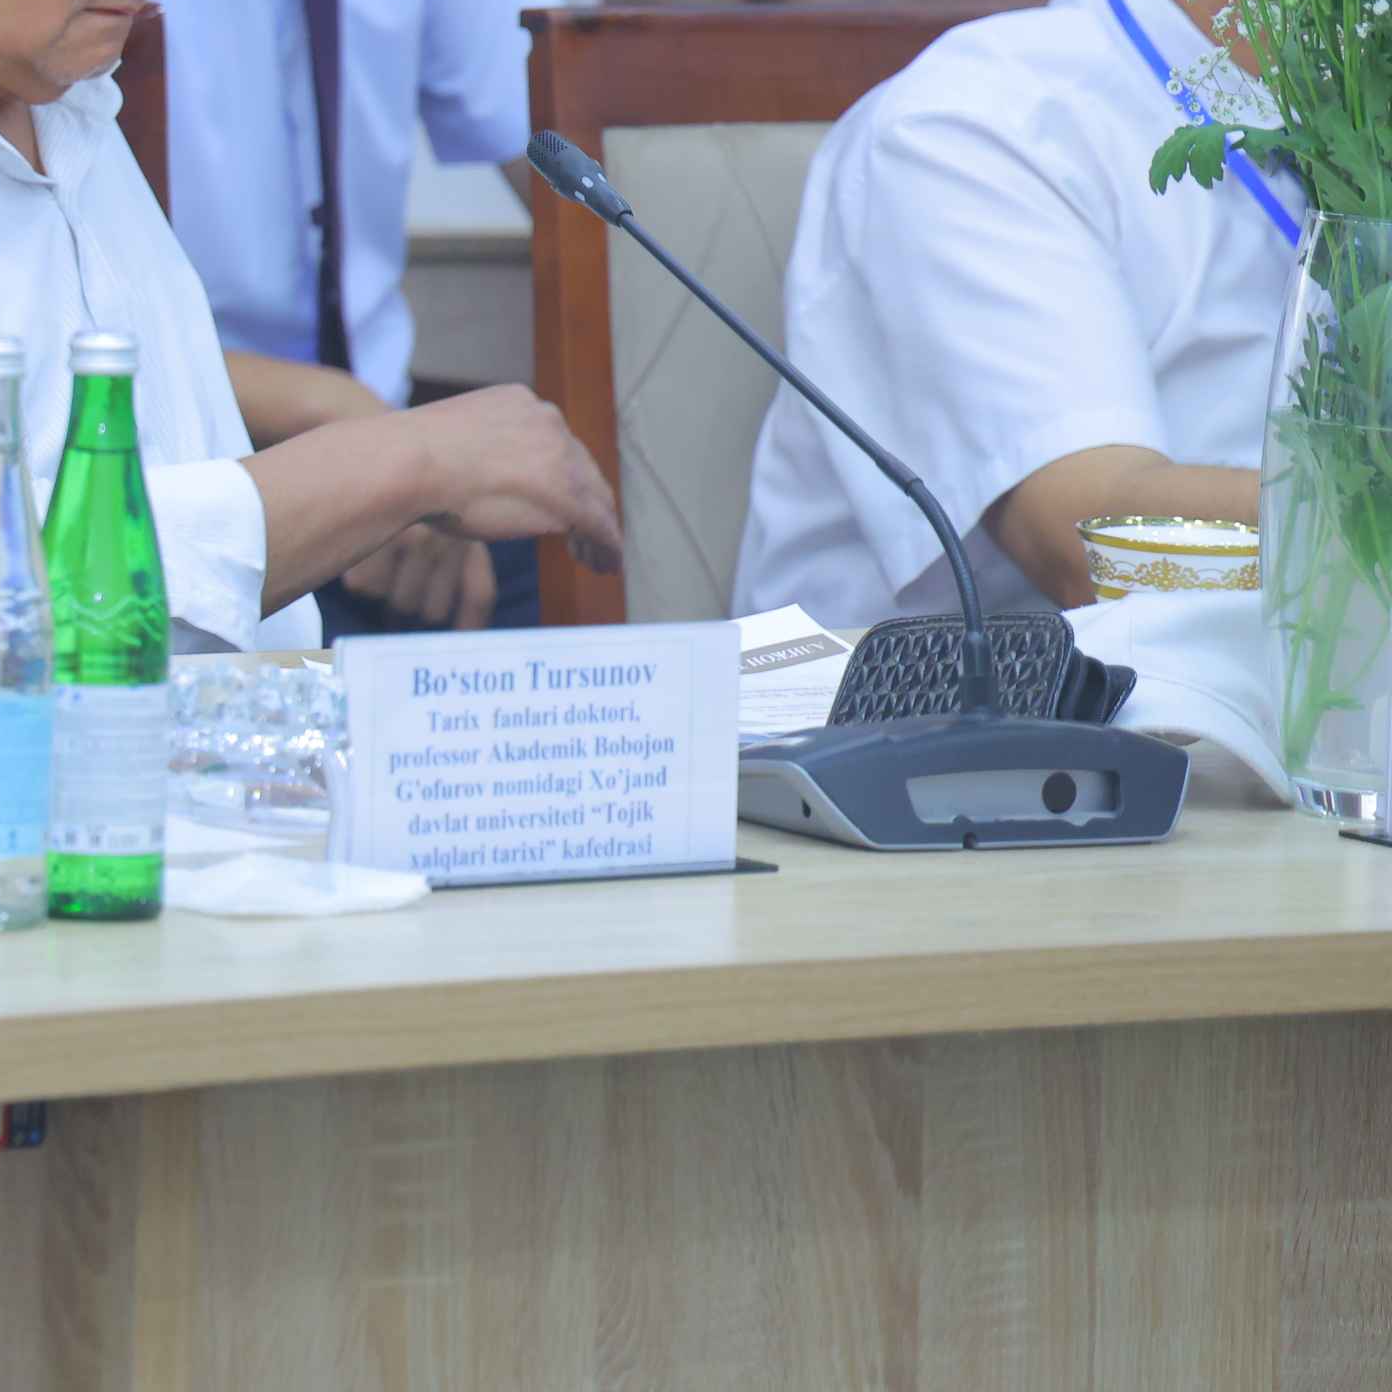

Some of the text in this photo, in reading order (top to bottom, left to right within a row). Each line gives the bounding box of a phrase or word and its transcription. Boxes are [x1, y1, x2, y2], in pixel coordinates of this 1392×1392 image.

[525, 659, 657, 691] Tursunov
[428, 709, 481, 733] Tarix
[493, 705, 558, 729] fanlari
[389, 733, 675, 774] professor Akademik Bobojon
[493, 772, 583, 796] nomidagi
[408, 813, 468, 835] davlat
[476, 807, 584, 831] universiteti
[563, 834, 652, 860] kafedrasi
